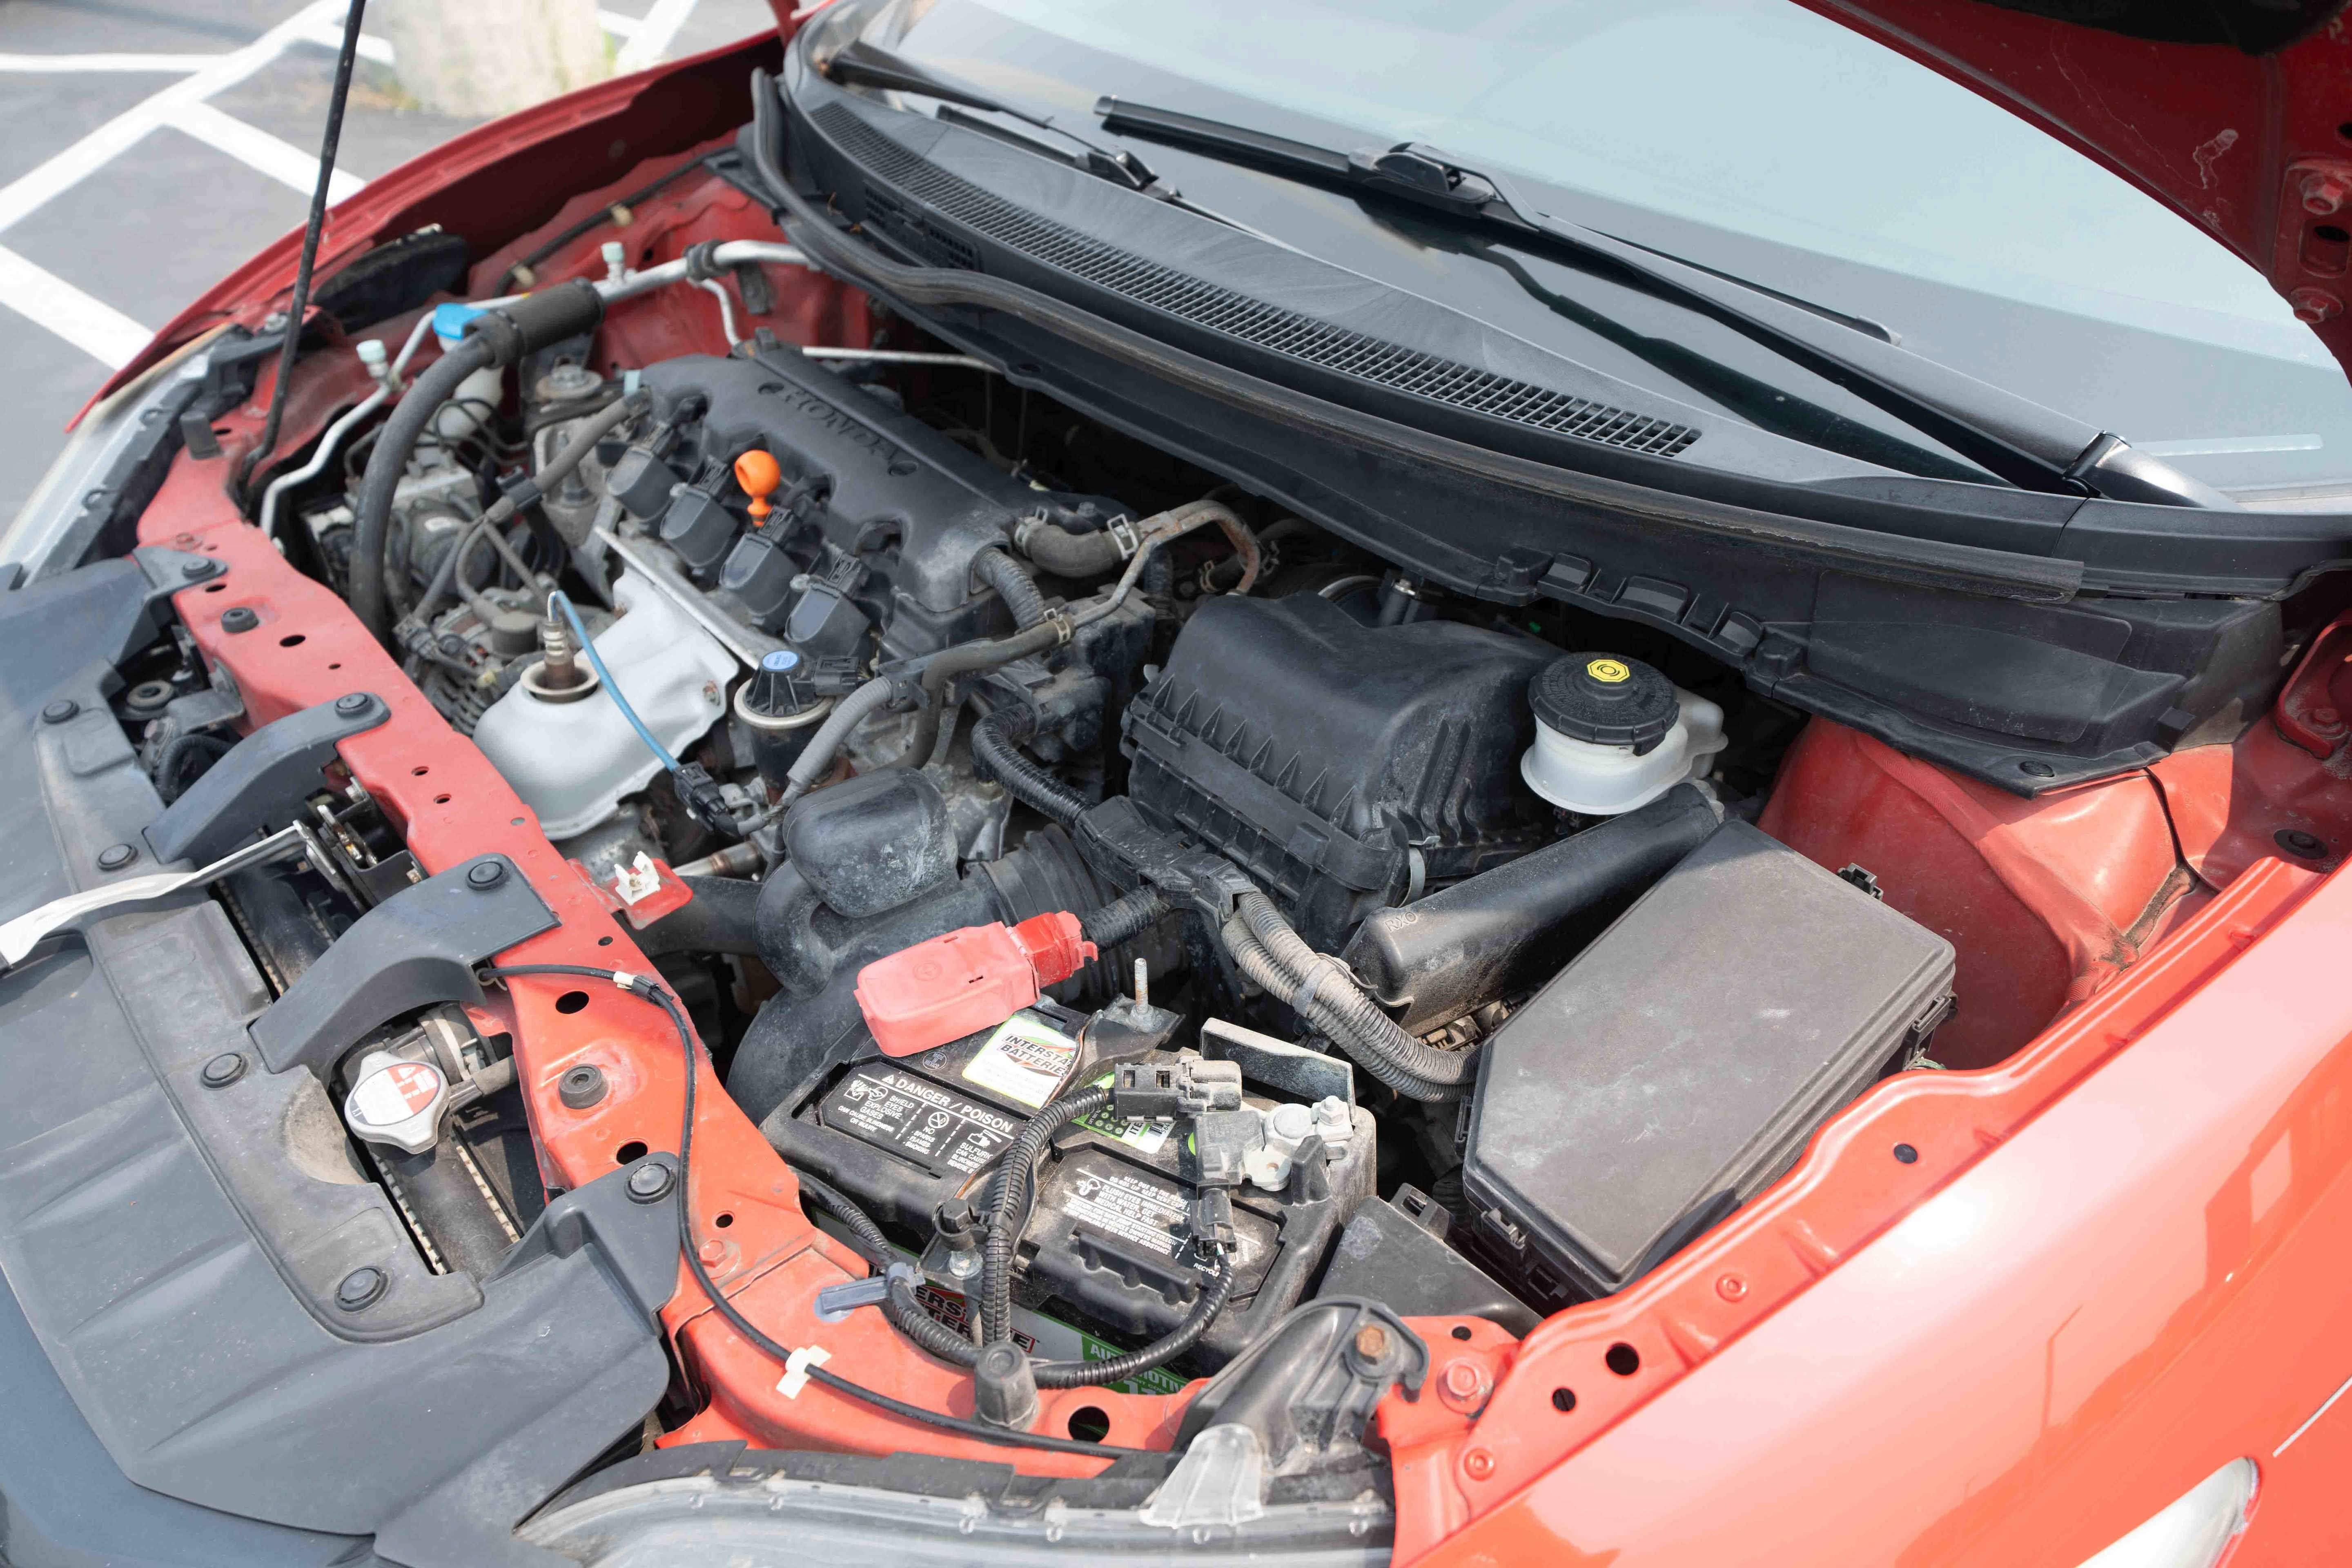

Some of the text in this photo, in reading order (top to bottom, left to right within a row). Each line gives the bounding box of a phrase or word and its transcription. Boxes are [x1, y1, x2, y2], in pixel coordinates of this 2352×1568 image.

[932, 1052, 944, 1060] MADE
[924, 1060, 940, 1069] MEXICO
[884, 1102, 903, 1113] EYES
[889, 1096, 914, 1109] SHIELD
[895, 1079, 951, 1108] DANGER
[960, 1106, 1014, 1133] POISON
[860, 1107, 884, 1120] GASES
[864, 1101, 902, 1119] EXPLOSIVE
[838, 1105, 895, 1133] CAN CAUSE BLINDNESS
[922, 1126, 935, 1135] NO
[1129, 1123, 1143, 1135] ITE
[956, 1149, 969, 1158] CAN
[947, 1160, 968, 1172] SEVERE
[1141, 1189, 1156, 1197] KEEP
[1158, 1189, 1169, 1198] THE
[1094, 1196, 1122, 1213] MEDICAL
[1123, 1207, 1142, 1218] HELP
[1098, 1191, 1116, 1203] WITH
[1141, 1207, 1155, 1218] GET
[1102, 1185, 1124, 1197] FLUSH
[1123, 1192, 1142, 1204] EYES
[1140, 1198, 1185, 1223] IMMEDIATELY
[1156, 1233, 1177, 1247] FOLLOW
